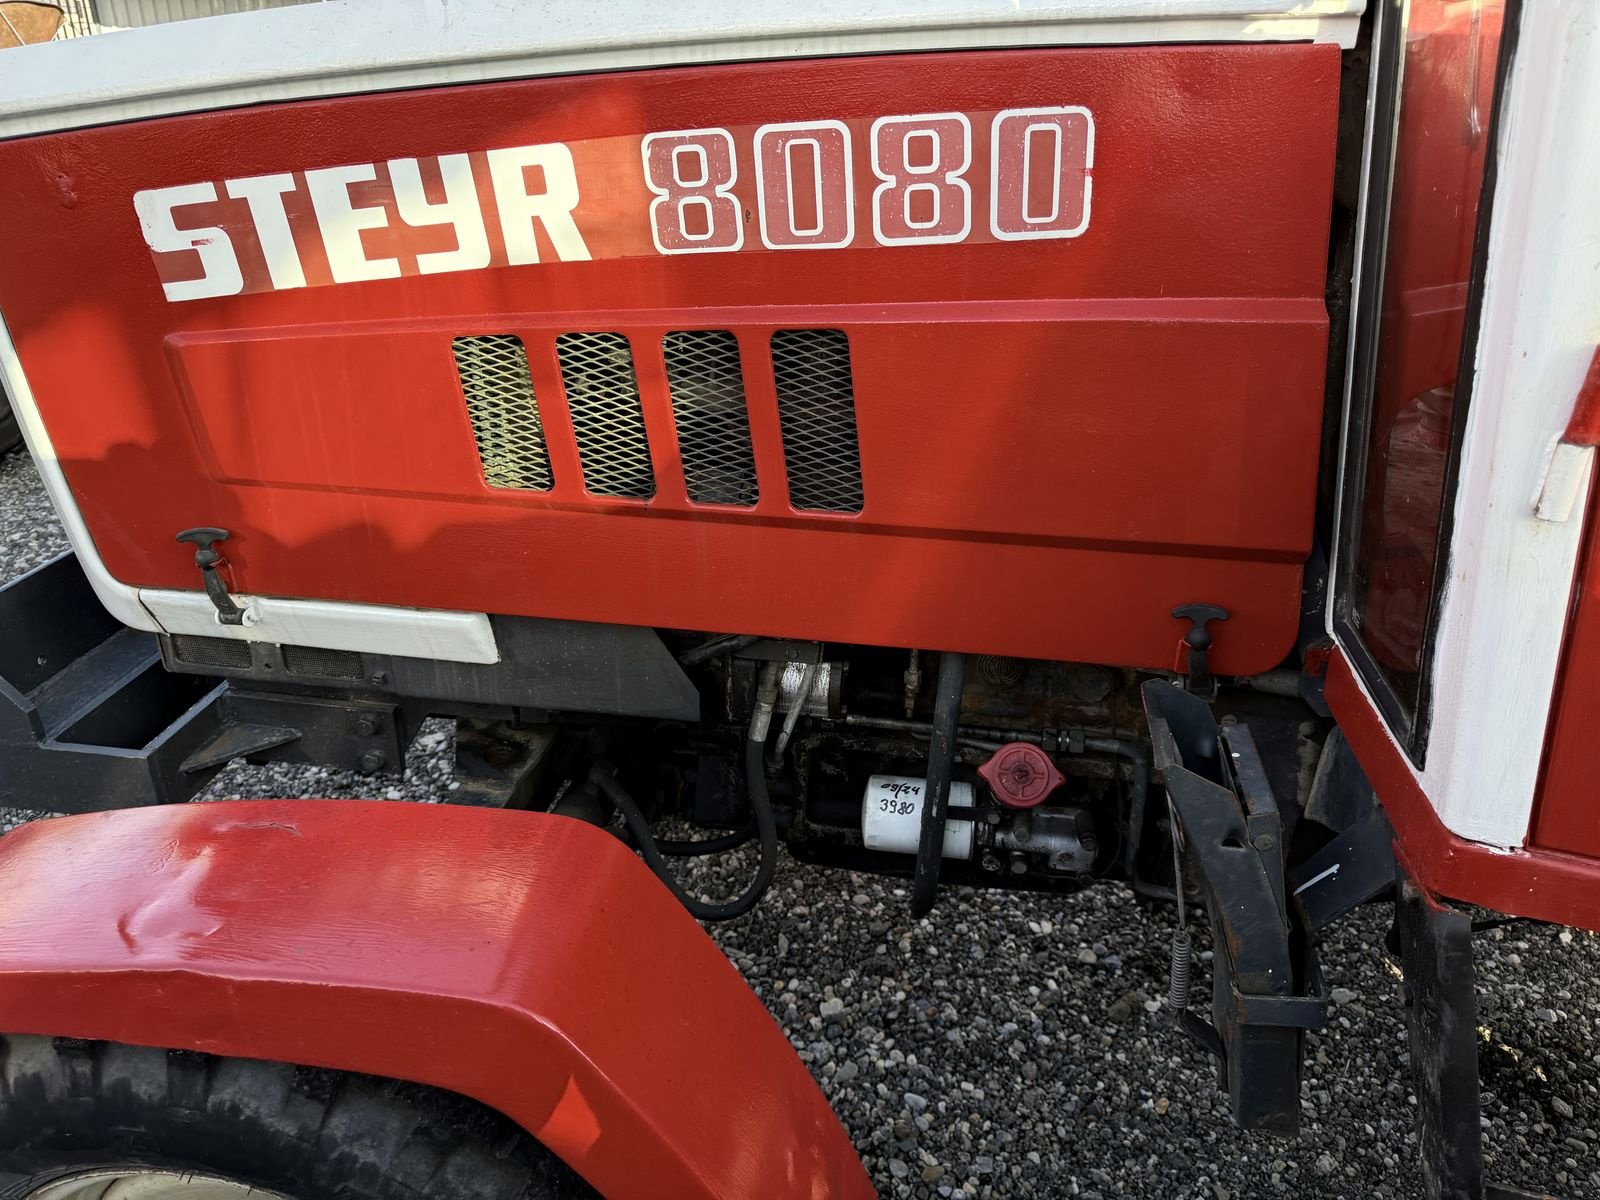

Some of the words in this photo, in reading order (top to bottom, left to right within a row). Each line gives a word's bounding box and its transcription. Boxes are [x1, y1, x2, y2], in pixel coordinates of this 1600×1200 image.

[133, 142, 592, 302] STEYR
[641, 105, 1096, 256] 8080
[879, 798, 915, 816] 3980
